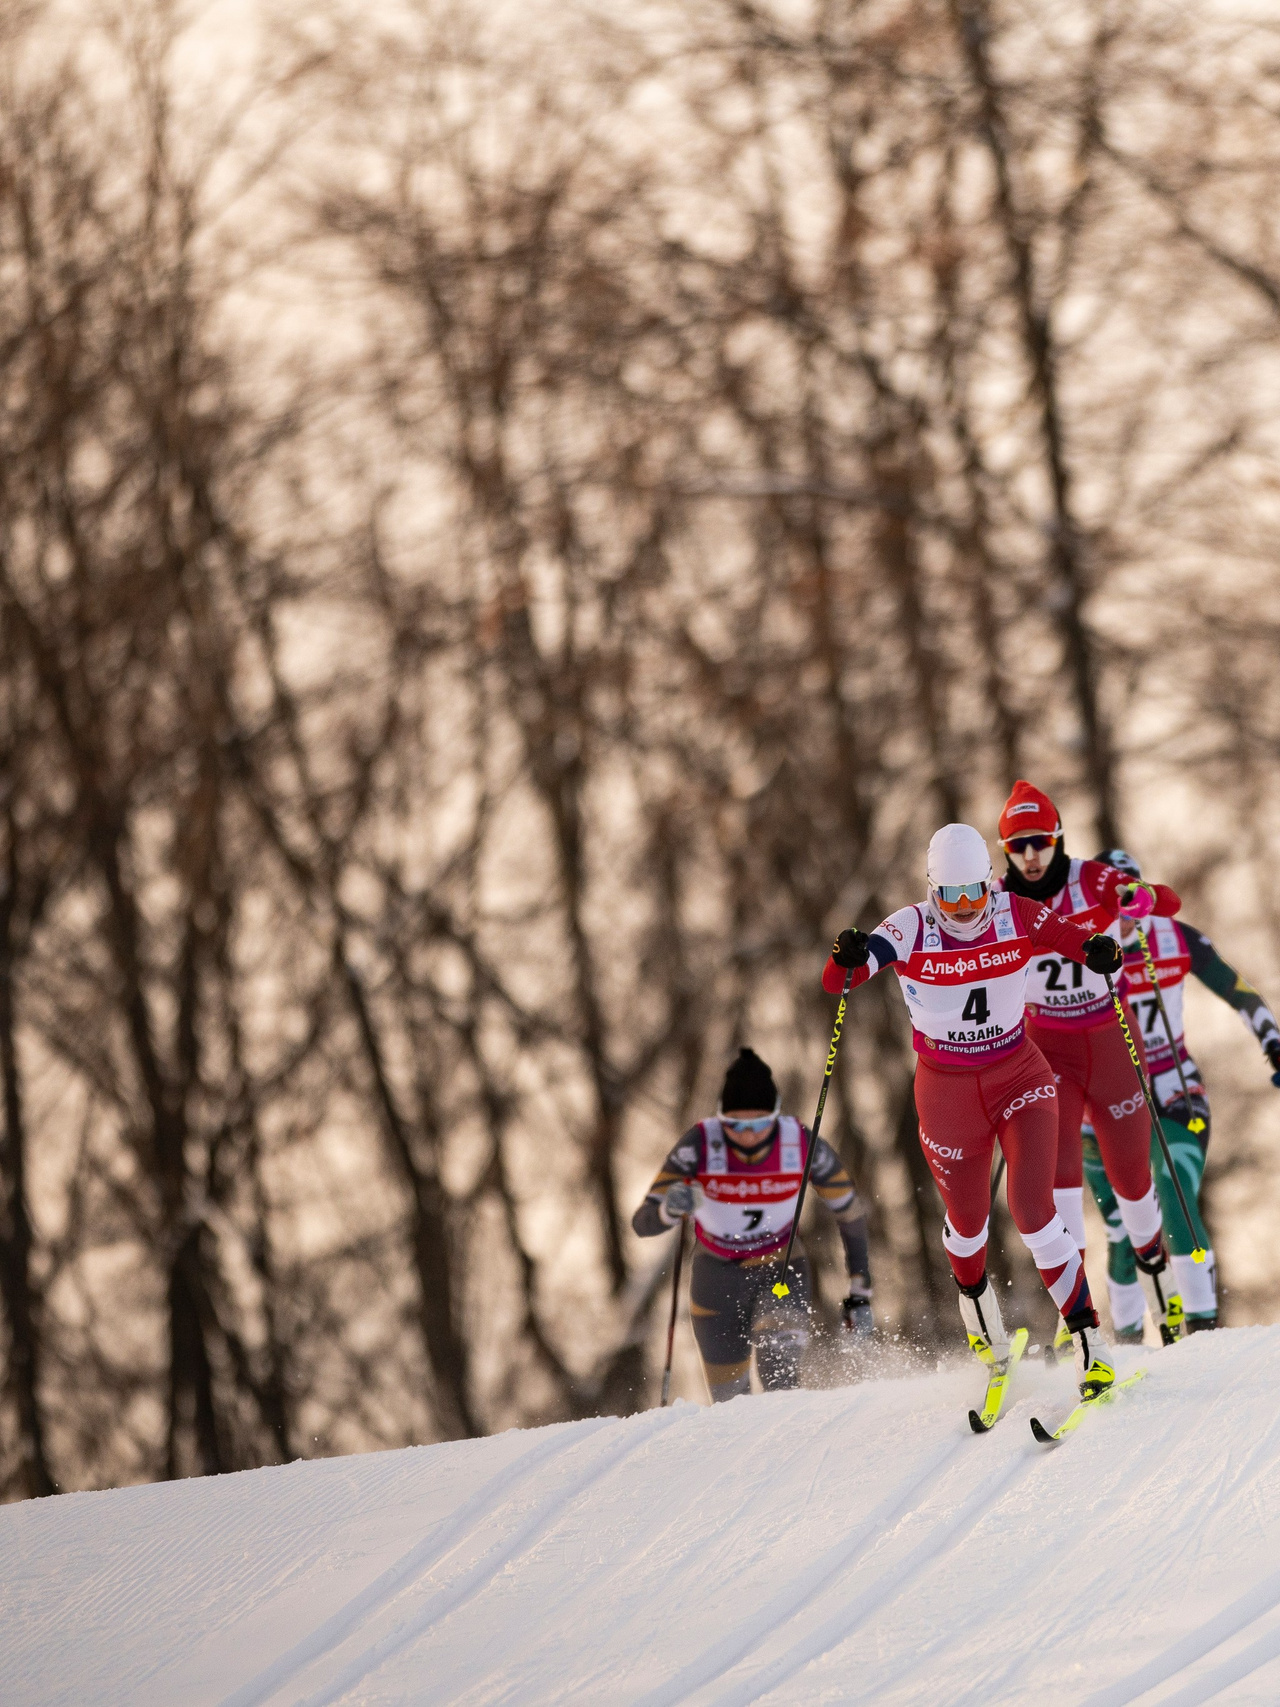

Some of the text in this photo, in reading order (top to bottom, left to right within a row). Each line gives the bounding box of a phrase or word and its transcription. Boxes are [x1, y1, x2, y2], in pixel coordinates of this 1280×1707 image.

[920, 948, 1022, 977] Альфа Банк
[1037, 957, 1083, 991] 27
[961, 986, 991, 1026] 4
[1044, 989, 1096, 1006] КАЗАНЬ
[947, 1024, 1004, 1042] КАЗАНЬ
[938, 1044, 991, 1054] РЕСПУБЛИКА
[1002, 1084, 1056, 1120] BOSCO
[1108, 1091, 1144, 1120] BOS
[919, 1126, 963, 1160] LUKOIL
[742, 1209, 764, 1232] 7
